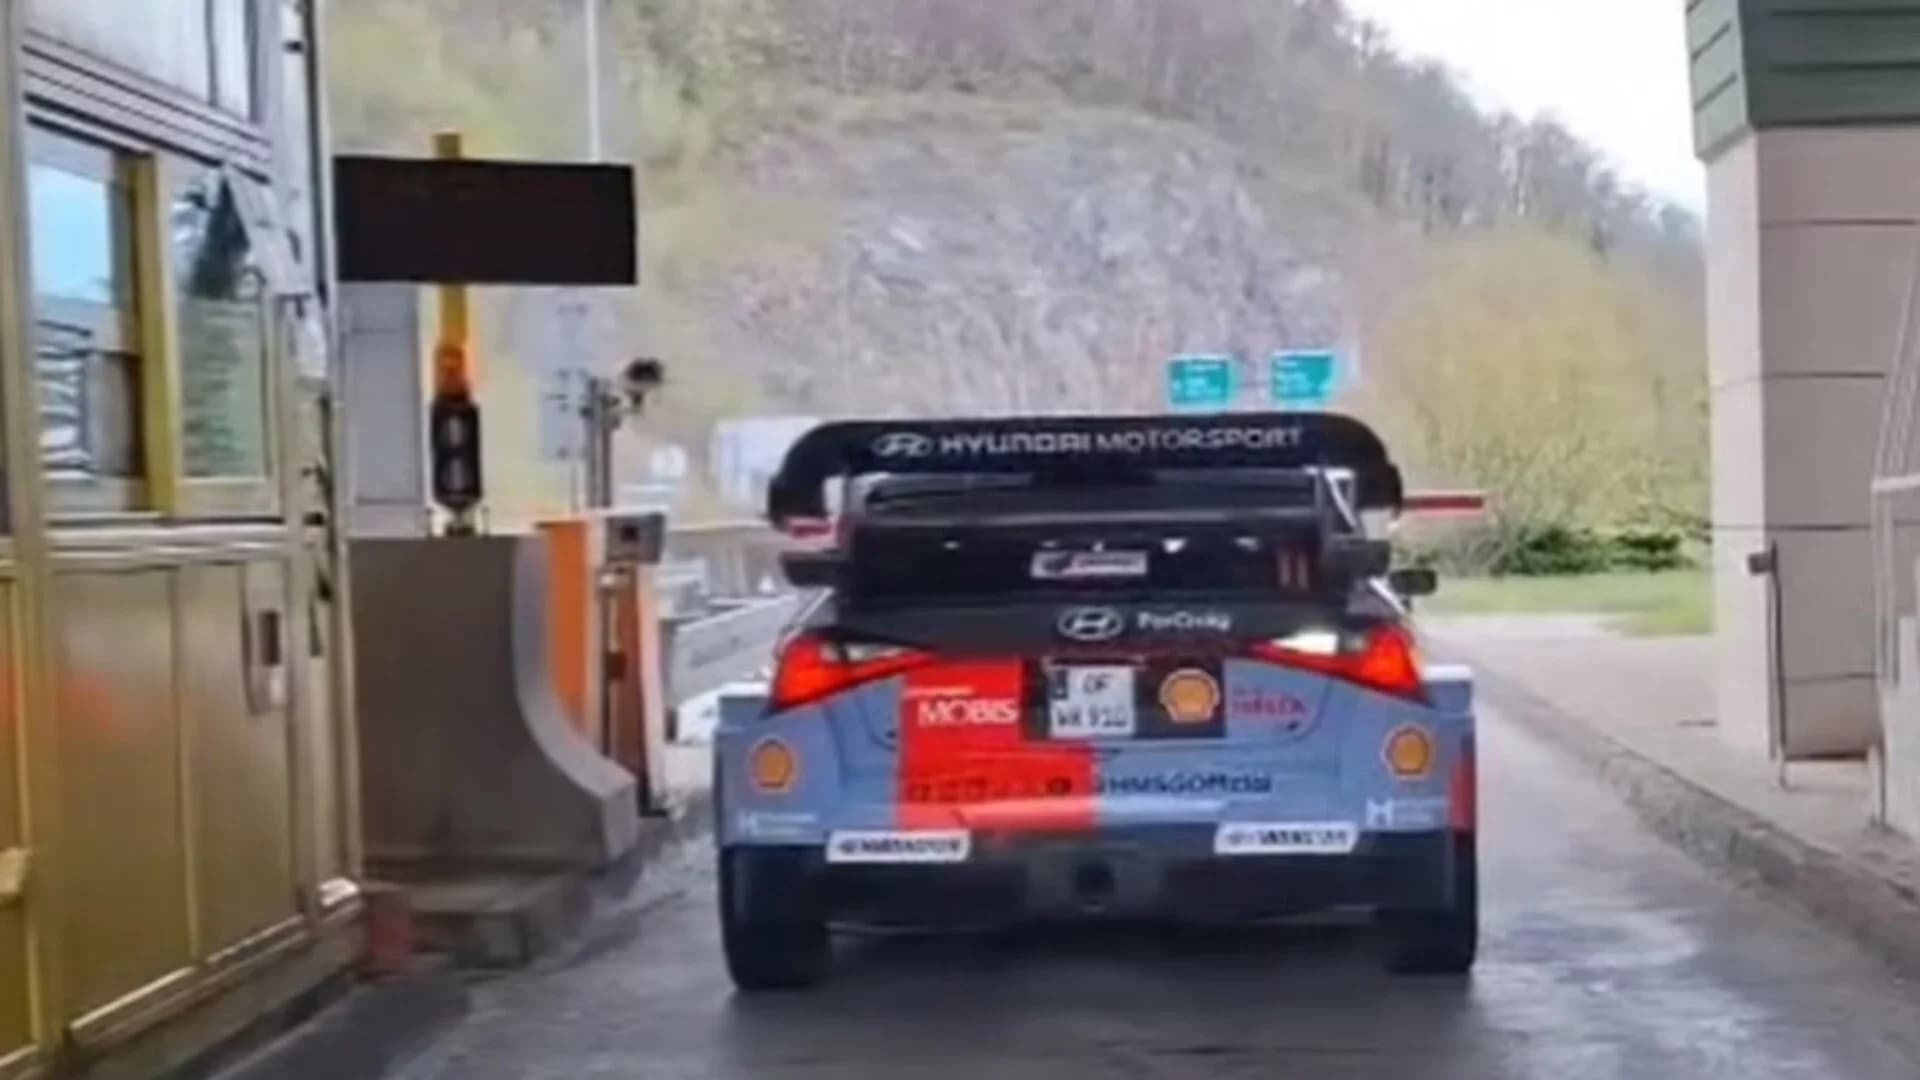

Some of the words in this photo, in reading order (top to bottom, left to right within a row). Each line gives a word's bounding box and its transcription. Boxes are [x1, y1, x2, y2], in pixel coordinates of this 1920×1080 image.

[940, 432, 1091, 454] HYUNDAI
[1095, 427, 1303, 453] MOTORSPORT
[918, 700, 1019, 726] MOBIS
